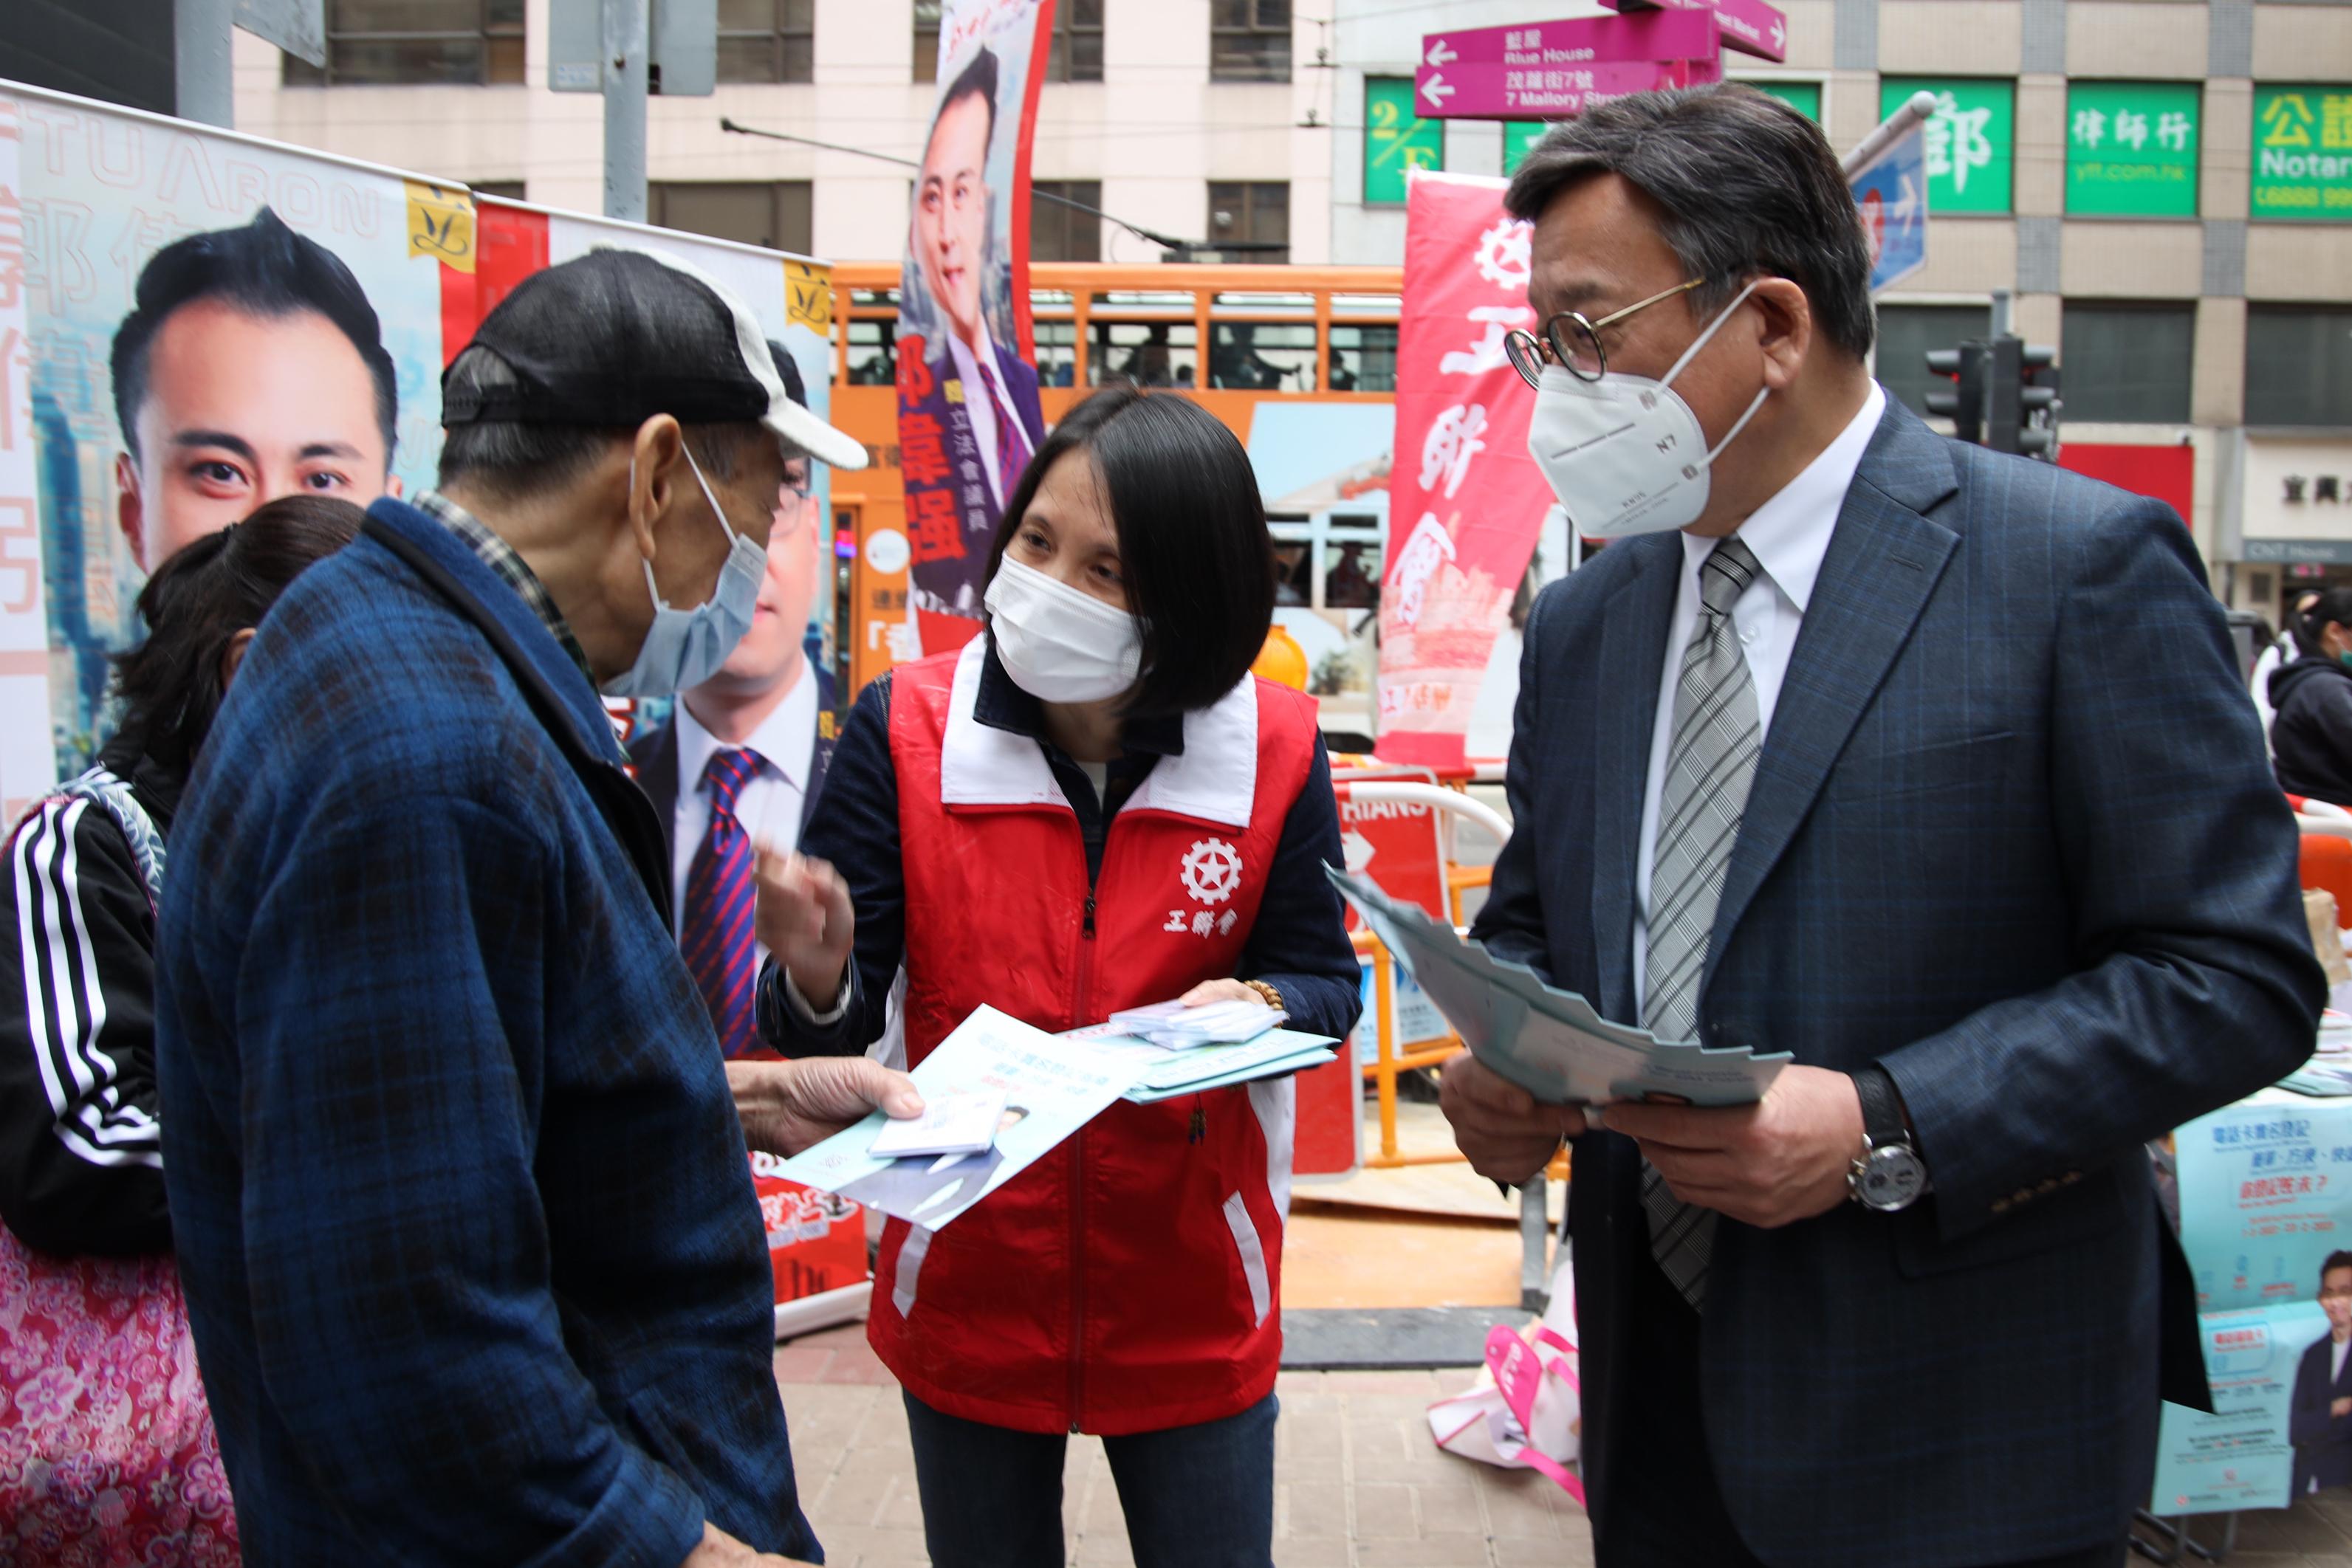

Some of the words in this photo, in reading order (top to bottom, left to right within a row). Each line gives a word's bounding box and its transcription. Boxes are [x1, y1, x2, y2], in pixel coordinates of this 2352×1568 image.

[1505, 29, 1542, 50] 藍屋
[1543, 46, 1596, 63] House
[1505, 92, 1516, 107] 7
[1519, 91, 1580, 109] Mallory
[2072, 108, 2192, 151] 律師行
[1162, 907, 1238, 940] 工聯會
